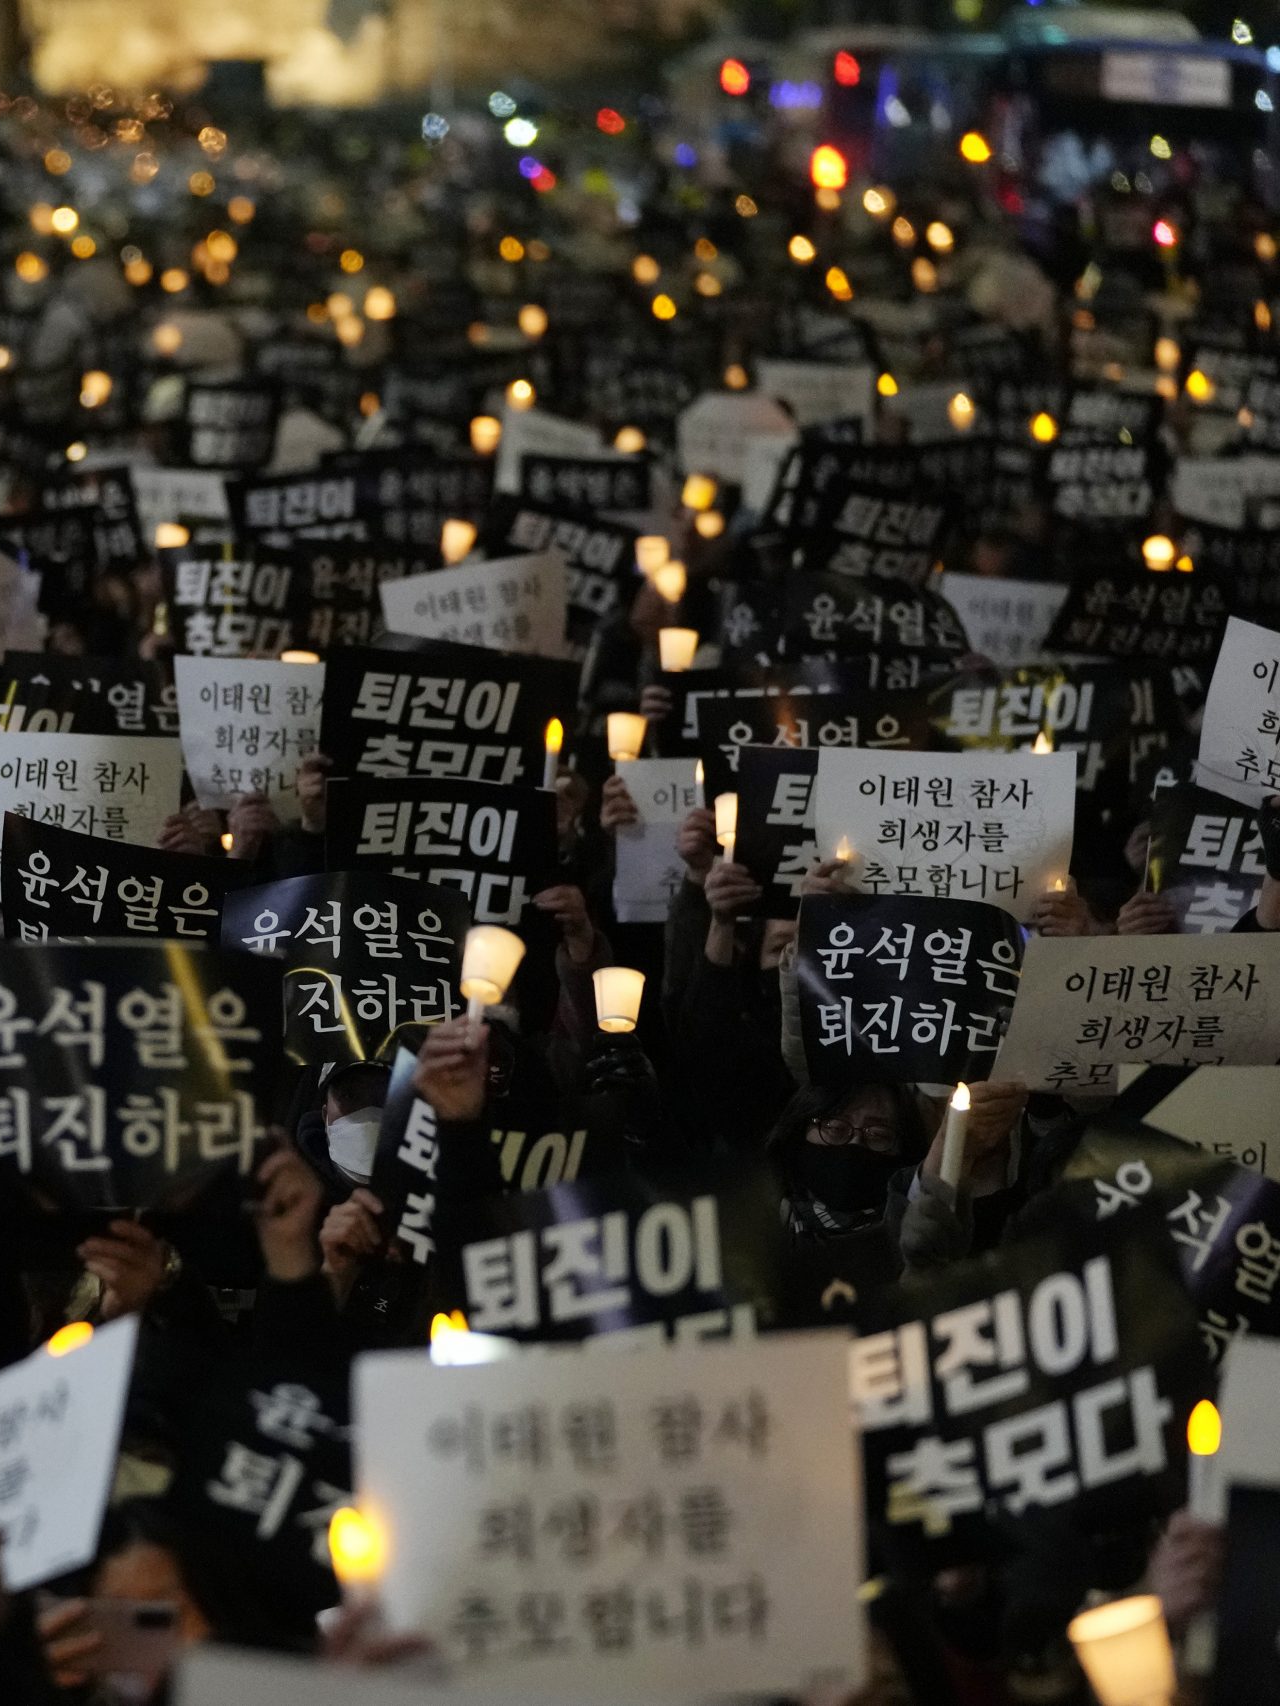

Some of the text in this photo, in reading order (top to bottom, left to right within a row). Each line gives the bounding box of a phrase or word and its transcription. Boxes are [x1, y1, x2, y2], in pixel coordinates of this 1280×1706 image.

[174, 560, 292, 612] 퇴진이
[200, 682, 272, 716] 이태원
[351, 671, 521, 735] 퇴진이
[945, 681, 1096, 738] 퇴진이
[213, 727, 320, 758] 희생자를
[354, 734, 525, 785] 추모다
[0, 756, 79, 795] 이태원
[93, 759, 151, 796] 참사
[210, 765, 299, 797] 추모합니
[858, 774, 955, 809] 이태원
[969, 777, 1034, 811] 참사
[356, 801, 519, 864] 퇴진이
[876, 818, 1010, 853] 희생자를
[17, 849, 219, 937] 윤석열은
[391, 867, 536, 927] 모다
[861, 864, 1025, 900] 추모합니다
[241, 900, 456, 965] 윤석열은
[816, 921, 1022, 997] 윤석열은
[296, 972, 462, 1034] 진하라
[1064, 963, 1261, 1003] 이태원 참사
[1075, 1015, 1224, 1051] 희생자를
[461, 1195, 725, 1336] 퇴진이
[848, 1254, 1122, 1430] 퇴진이
[884, 1364, 1174, 1539] 추모다
